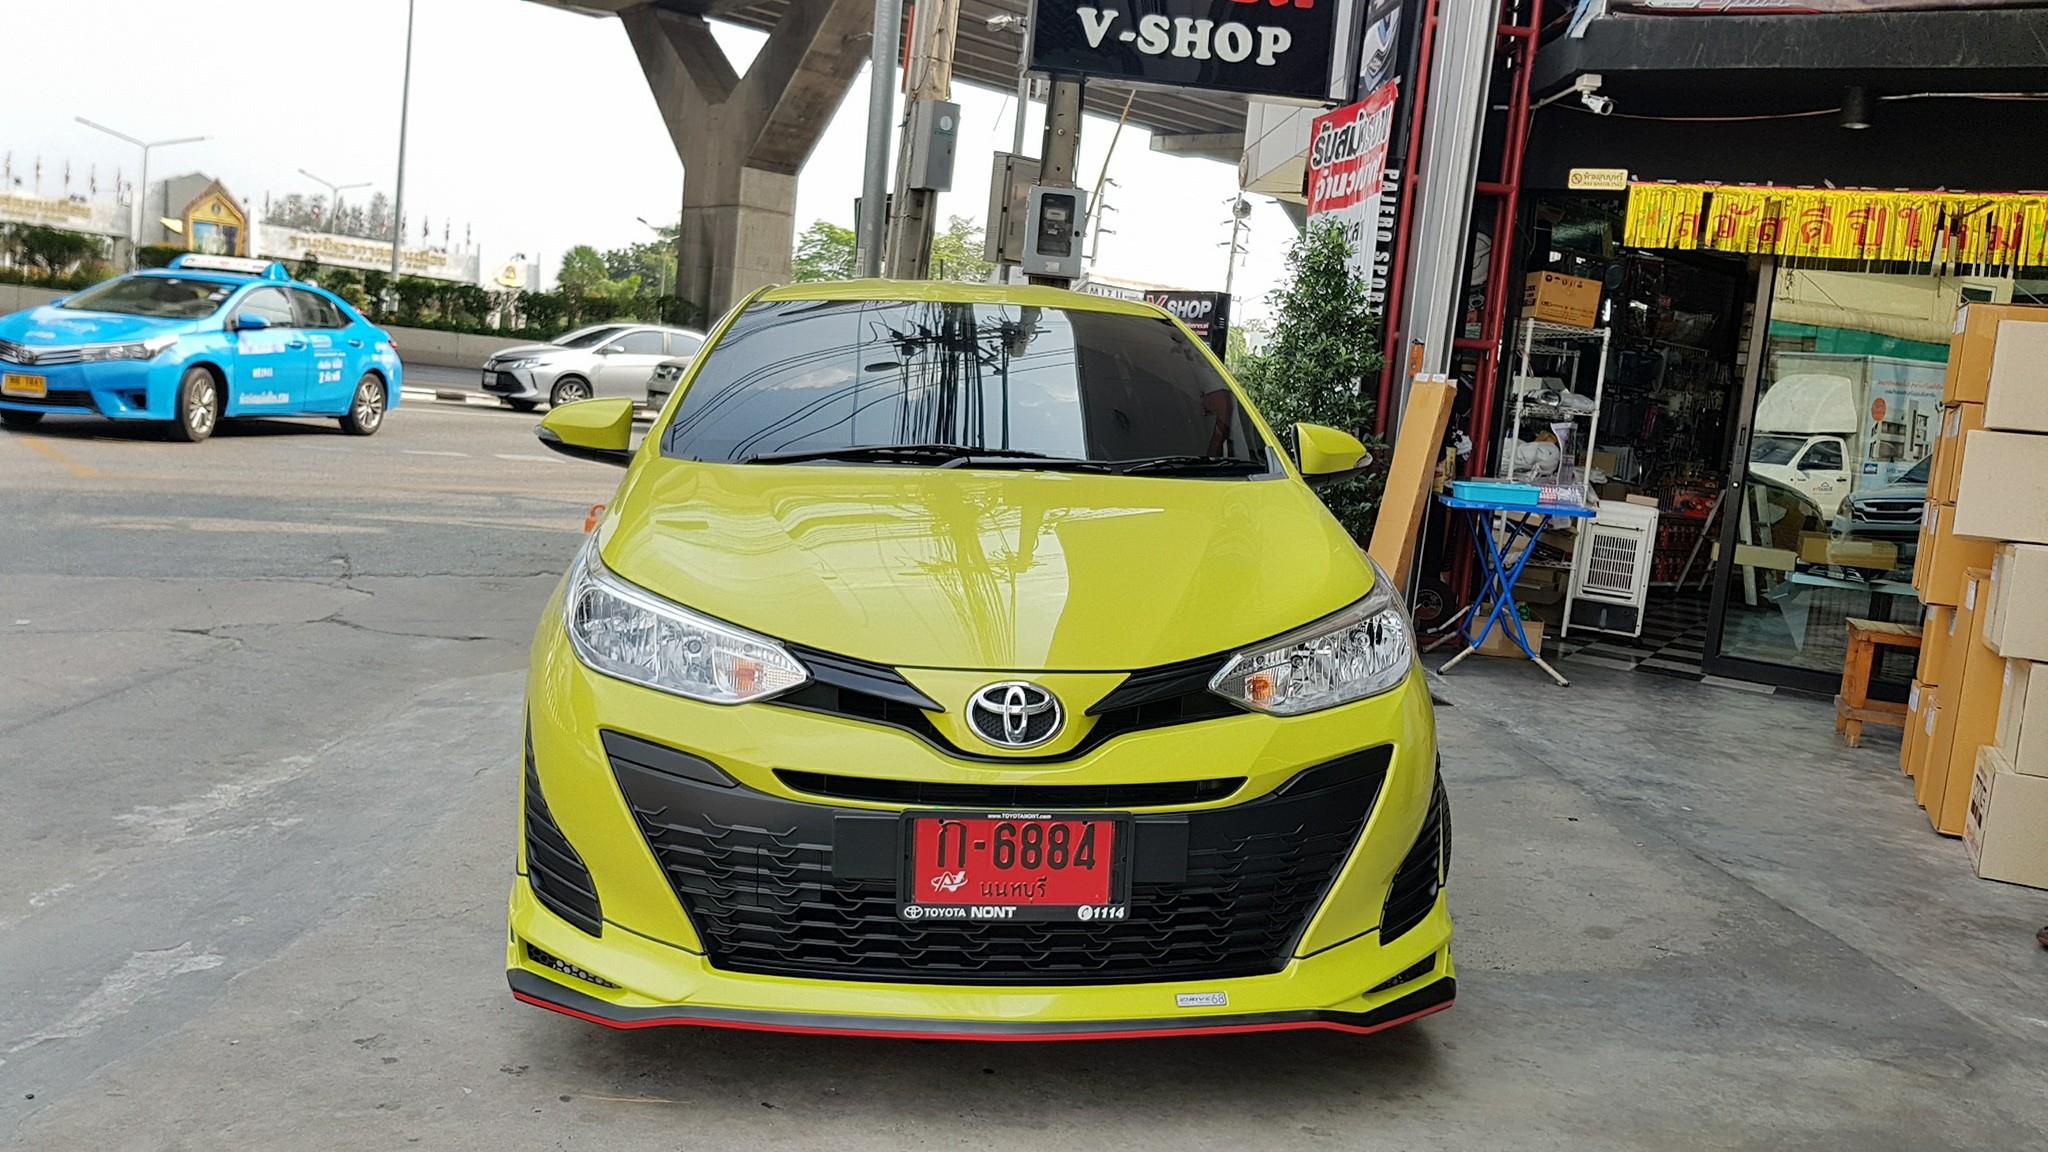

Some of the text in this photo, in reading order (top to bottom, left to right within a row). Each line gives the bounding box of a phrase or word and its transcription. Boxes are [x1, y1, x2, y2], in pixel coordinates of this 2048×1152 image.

[1076, 7, 1293, 66] V-SHOP
[1369, 168, 1400, 317] PAJERO SPORT
[980, 875, 1048, 904] นนทบุรี
[923, 906, 1017, 919] TOYOTA NONT
[1092, 906, 1125, 919] 1114
